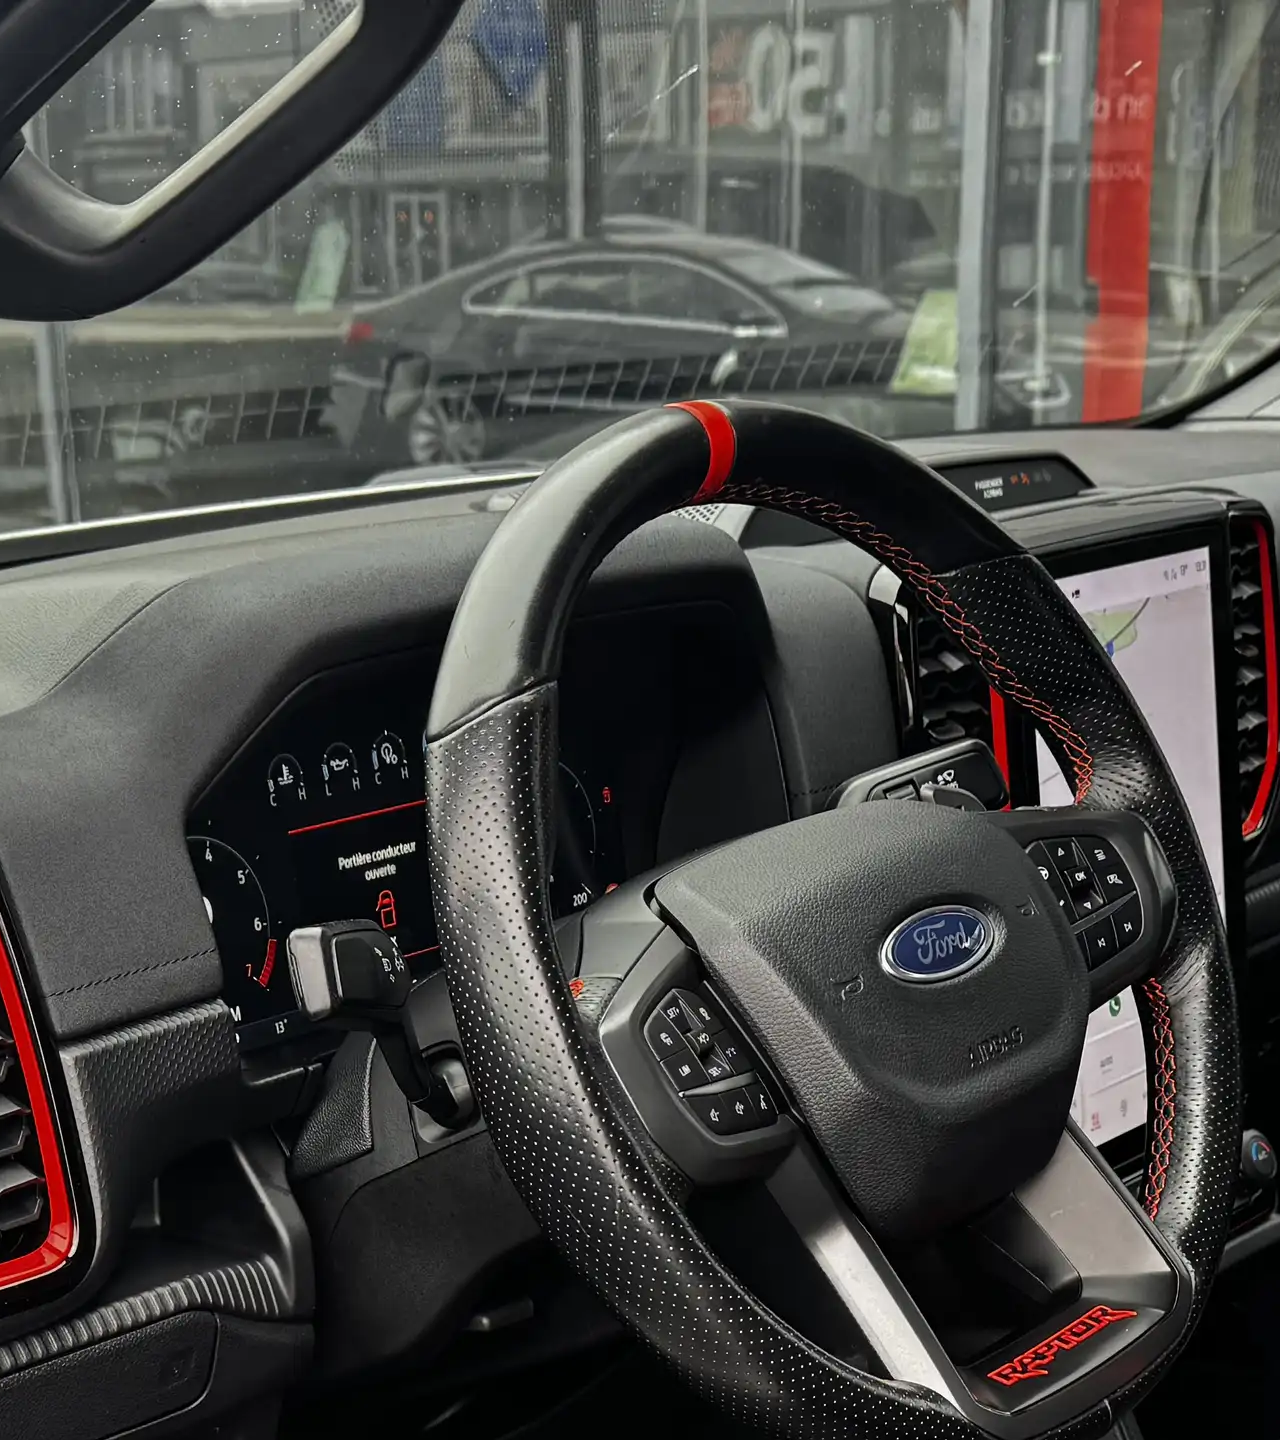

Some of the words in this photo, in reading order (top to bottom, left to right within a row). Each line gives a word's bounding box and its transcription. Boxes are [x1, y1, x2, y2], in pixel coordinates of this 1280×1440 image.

[401, 767, 409, 779] H
[298, 788, 307, 800] H
[325, 783, 332, 796] L
[352, 778, 361, 790] H
[205, 848, 213, 862] 4
[338, 852, 372, 870] Portière
[372, 841, 416, 860] conducteur
[238, 870, 246, 884] 5
[365, 864, 396, 881] ouverte
[1075, 871, 1087, 882] OK
[573, 892, 588, 907] 200
[254, 917, 262, 931] 6
[913, 919, 983, 964] Ford
[246, 963, 252, 977] 7
[679, 1064, 692, 1077] LIM
[987, 1304, 1138, 1387] RAPTOR
